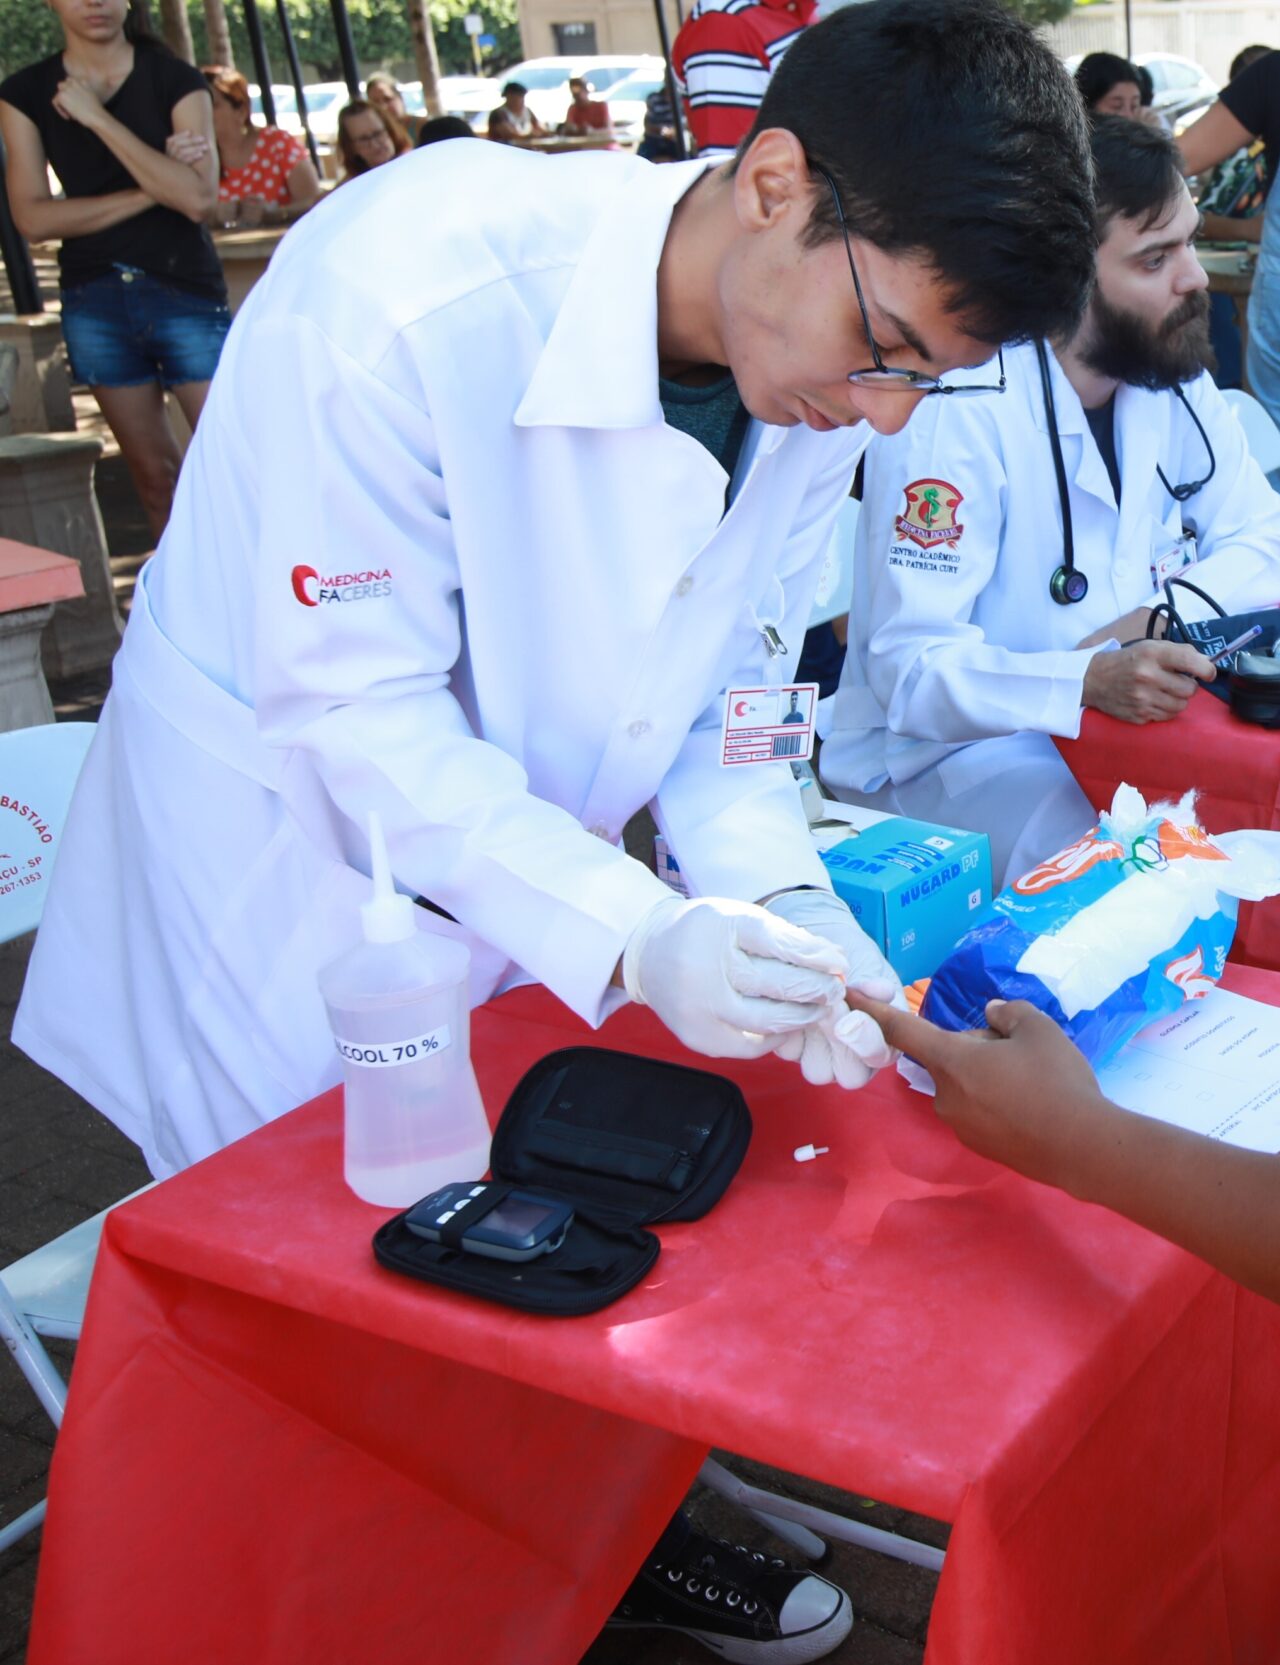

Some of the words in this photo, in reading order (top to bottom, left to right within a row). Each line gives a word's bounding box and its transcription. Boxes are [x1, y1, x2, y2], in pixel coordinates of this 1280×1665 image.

[890, 546, 918, 557] CENTRO
[919, 551, 961, 563] ACADÊMICO
[906, 559, 938, 571] PATRÍCIA
[939, 564, 959, 574] CURY
[320, 569, 393, 587] MEDICINA
[319, 581, 393, 603] FACERES
[27, 856, 42, 869] SP
[901, 863, 961, 908] NUGARD
[961, 850, 979, 873] PF
[901, 932, 916, 946] 100
[392, 1044, 418, 1060] 70
[421, 1035, 439, 1052] %
